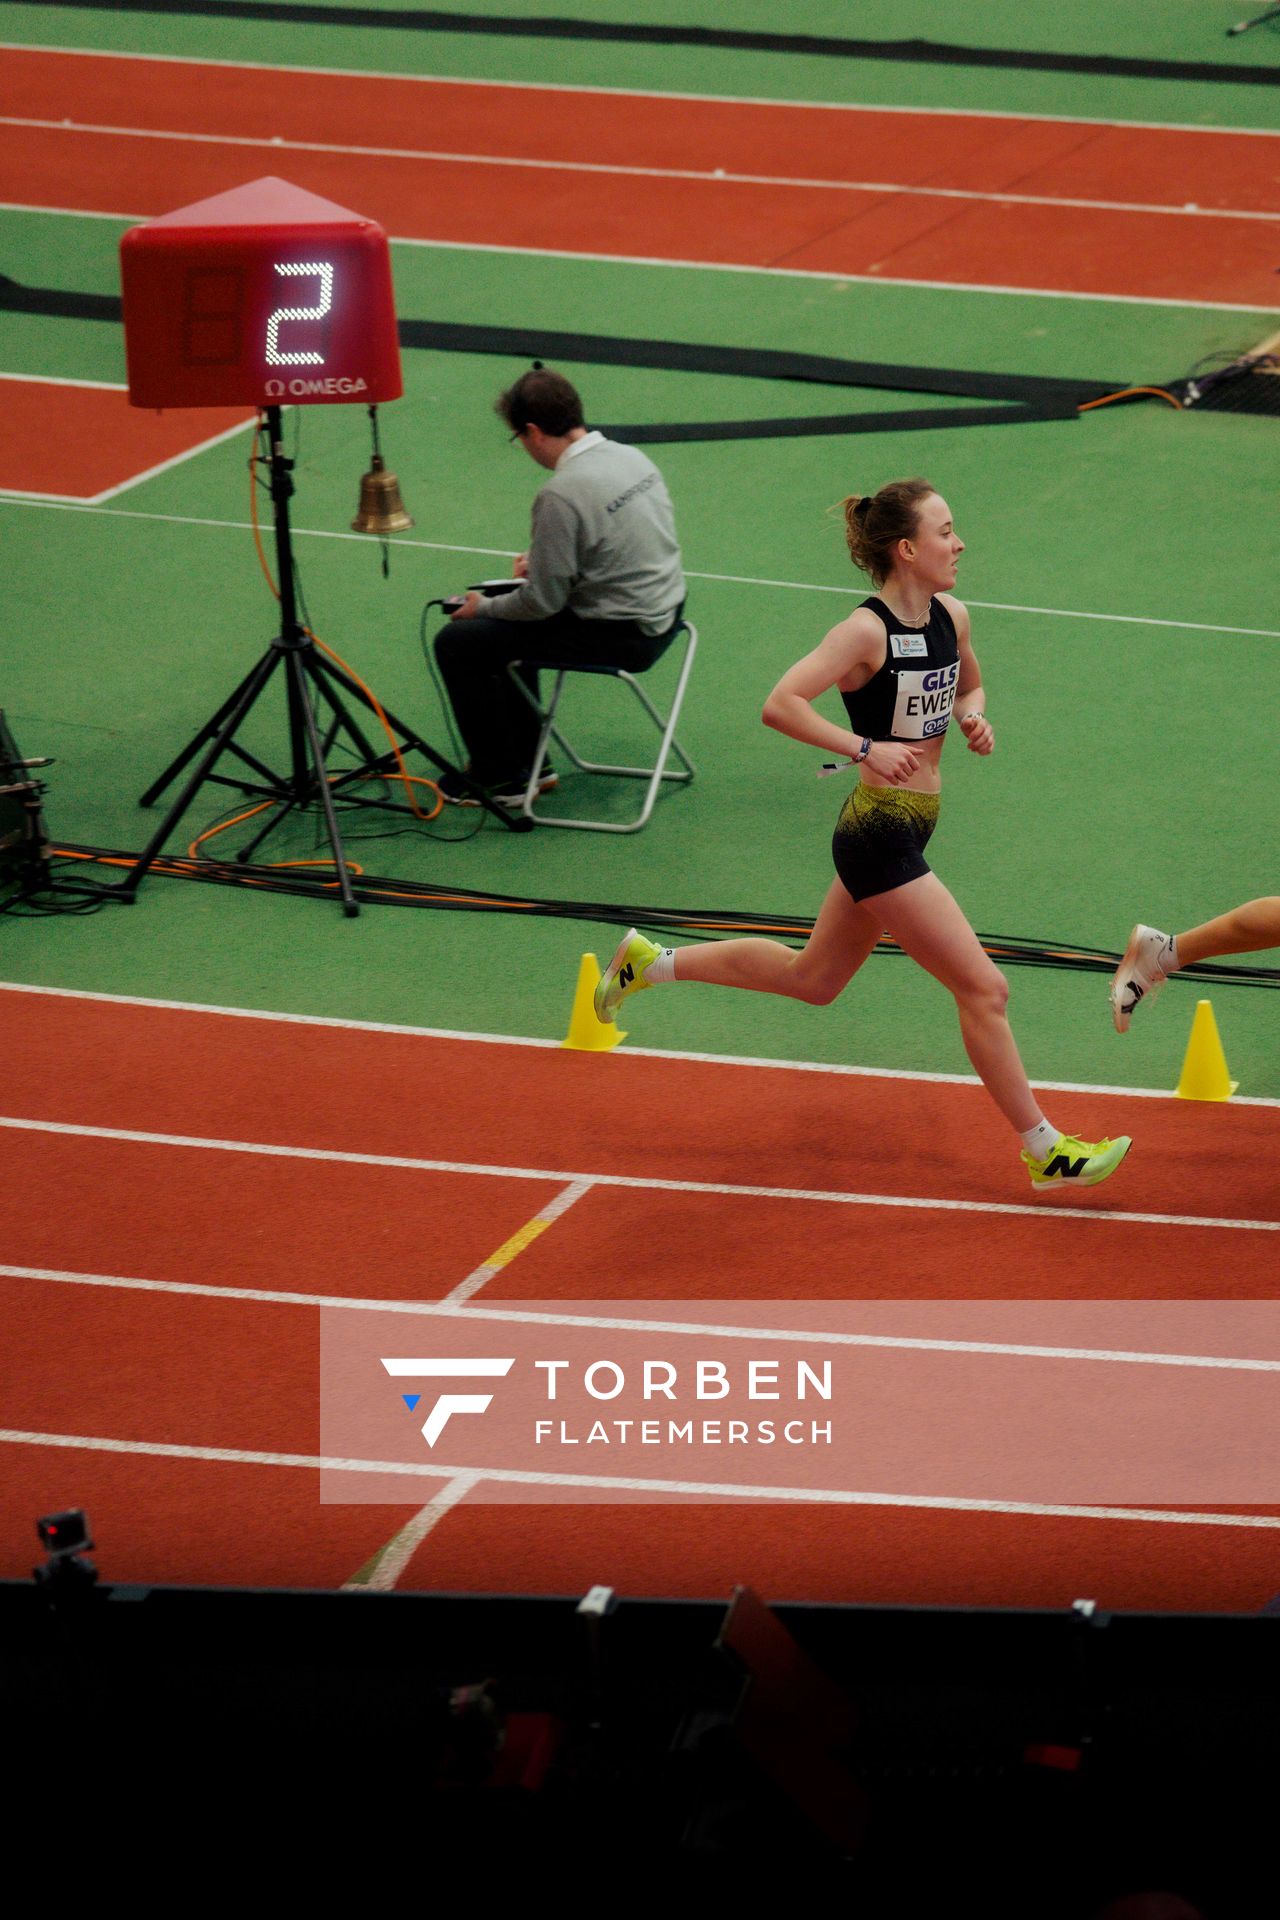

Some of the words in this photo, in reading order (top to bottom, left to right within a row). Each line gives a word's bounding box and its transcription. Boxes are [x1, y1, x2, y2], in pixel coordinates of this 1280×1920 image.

[266, 262, 333, 365] 2
[289, 377, 368, 396] OMEGA
[922, 665, 958, 692] GLS
